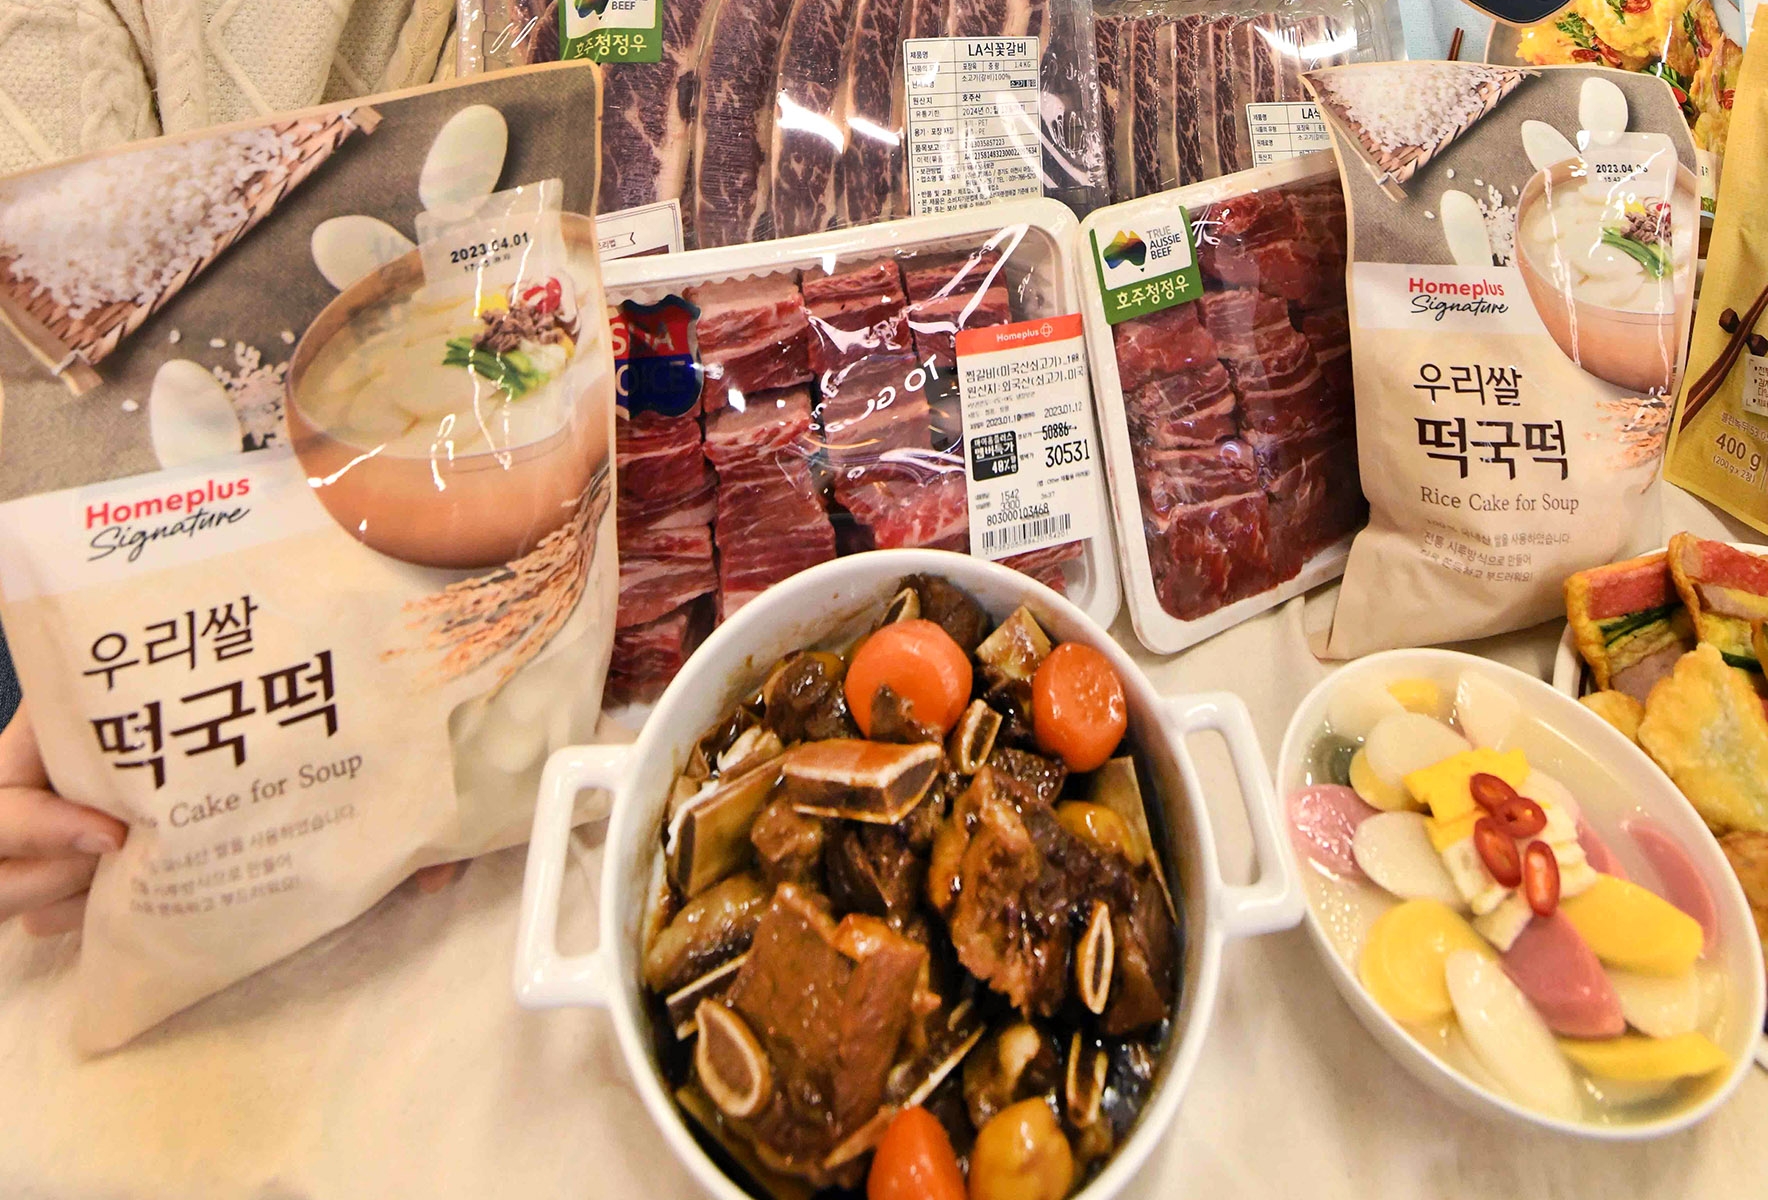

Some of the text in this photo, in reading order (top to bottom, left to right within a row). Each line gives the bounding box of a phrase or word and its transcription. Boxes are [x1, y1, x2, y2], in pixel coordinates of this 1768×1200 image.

[611, 1, 636, 10] BEEF
[574, 34, 647, 59] 호주청정우
[910, 42, 1027, 59] 제품명 LA식꽃갈비
[913, 93, 981, 105] 원산지 호주산
[1146, 225, 1172, 240] TRUE
[1149, 233, 1182, 250] AUSSIE
[1150, 246, 1173, 260] BEEF
[1116, 274, 1190, 310] 호주청정우
[1409, 277, 1505, 300] Homeplus
[1410, 294, 1509, 321] Signature
[996, 328, 1040, 343] Homeplus
[1413, 363, 1523, 407] 우리쌀
[1044, 401, 1083, 419] 2023.01.12
[1042, 421, 1069, 441] 50886
[1044, 439, 1090, 468] 30531
[1414, 416, 1569, 481] 떡국떡
[1716, 433, 1762, 472] 400 g
[85, 475, 251, 531] Homeplus
[1000, 488, 1019, 503] 1542
[1420, 485, 1580, 515] Rice Cake for Soup
[86, 505, 251, 563] Signature
[1423, 531, 1445, 549] 전통
[83, 595, 259, 691] 우리쌀
[89, 649, 339, 790] 떡국떡
[169, 792, 240, 829] Cake
[251, 778, 289, 804] for
[298, 754, 364, 789] Soup
